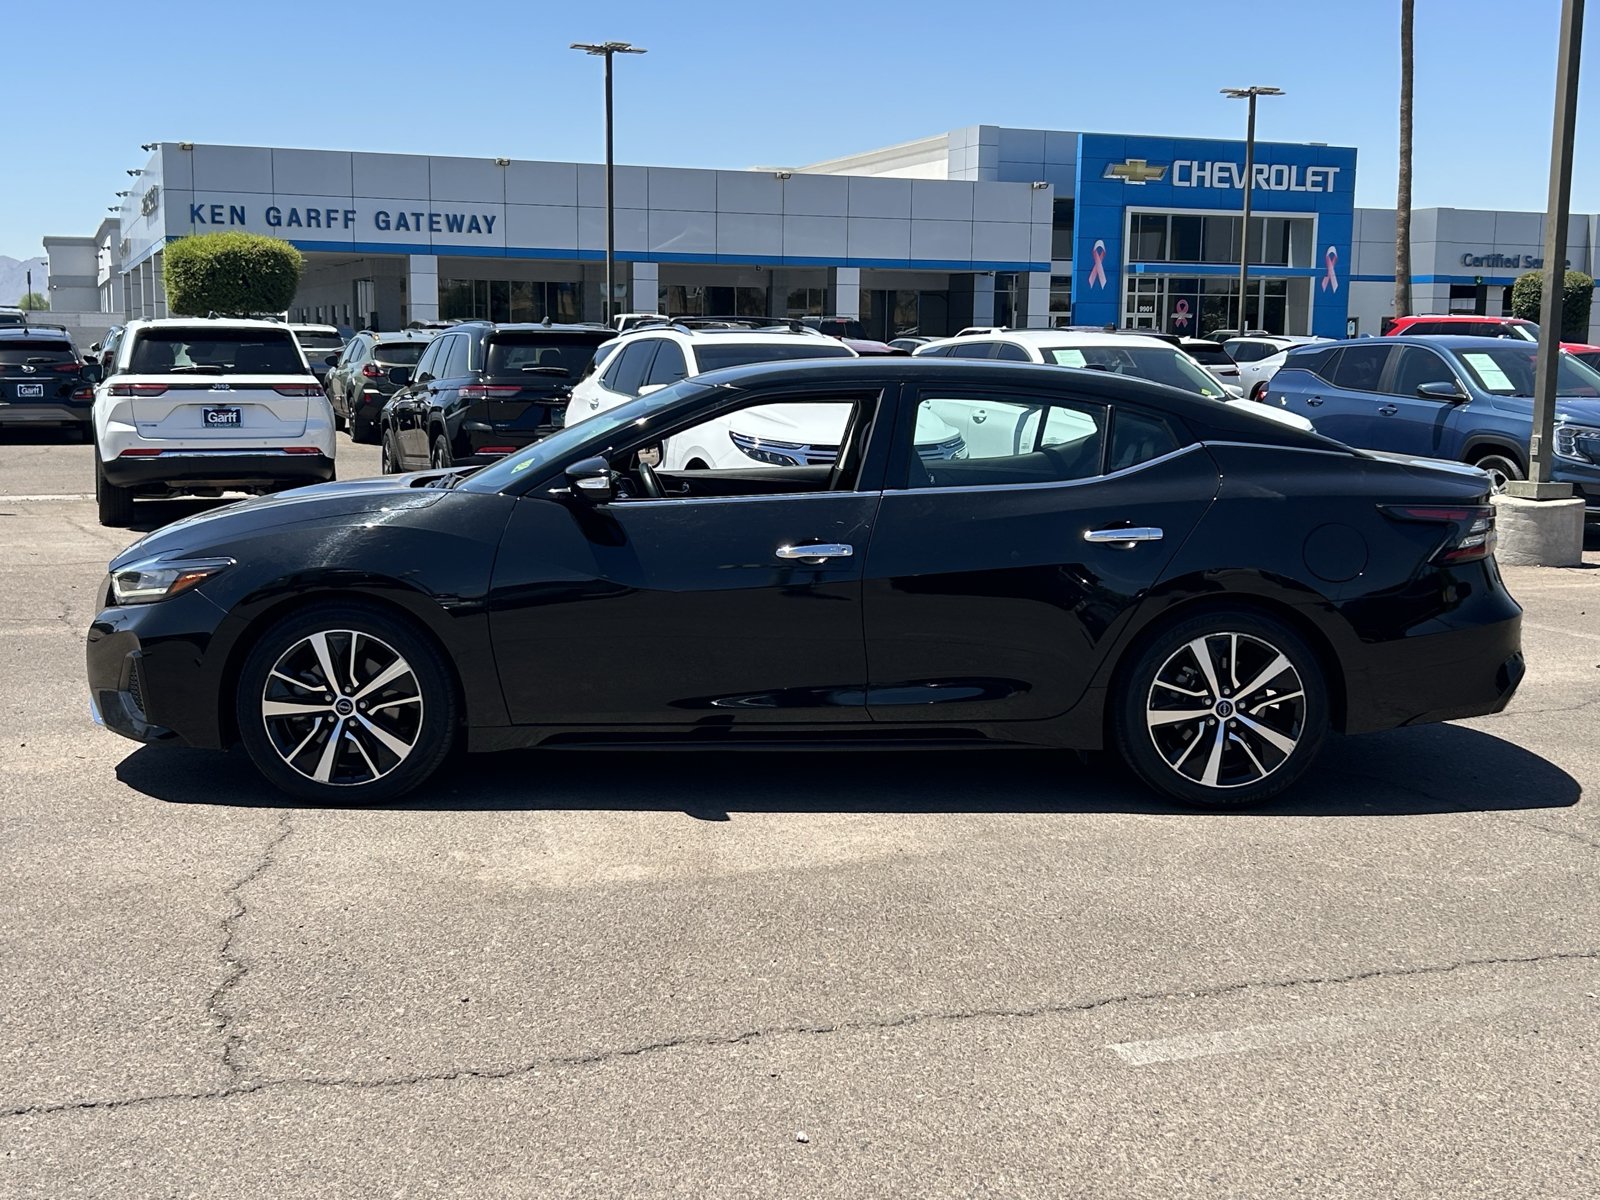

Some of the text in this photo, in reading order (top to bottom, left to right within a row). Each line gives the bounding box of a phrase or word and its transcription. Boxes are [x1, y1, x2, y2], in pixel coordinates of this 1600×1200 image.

[1172, 160, 1341, 192] CHEVROLET
[190, 203, 497, 234] KEN GARFF GATEWAY
[1462, 252, 1521, 268] Certified
[207, 411, 237, 423] Garff
